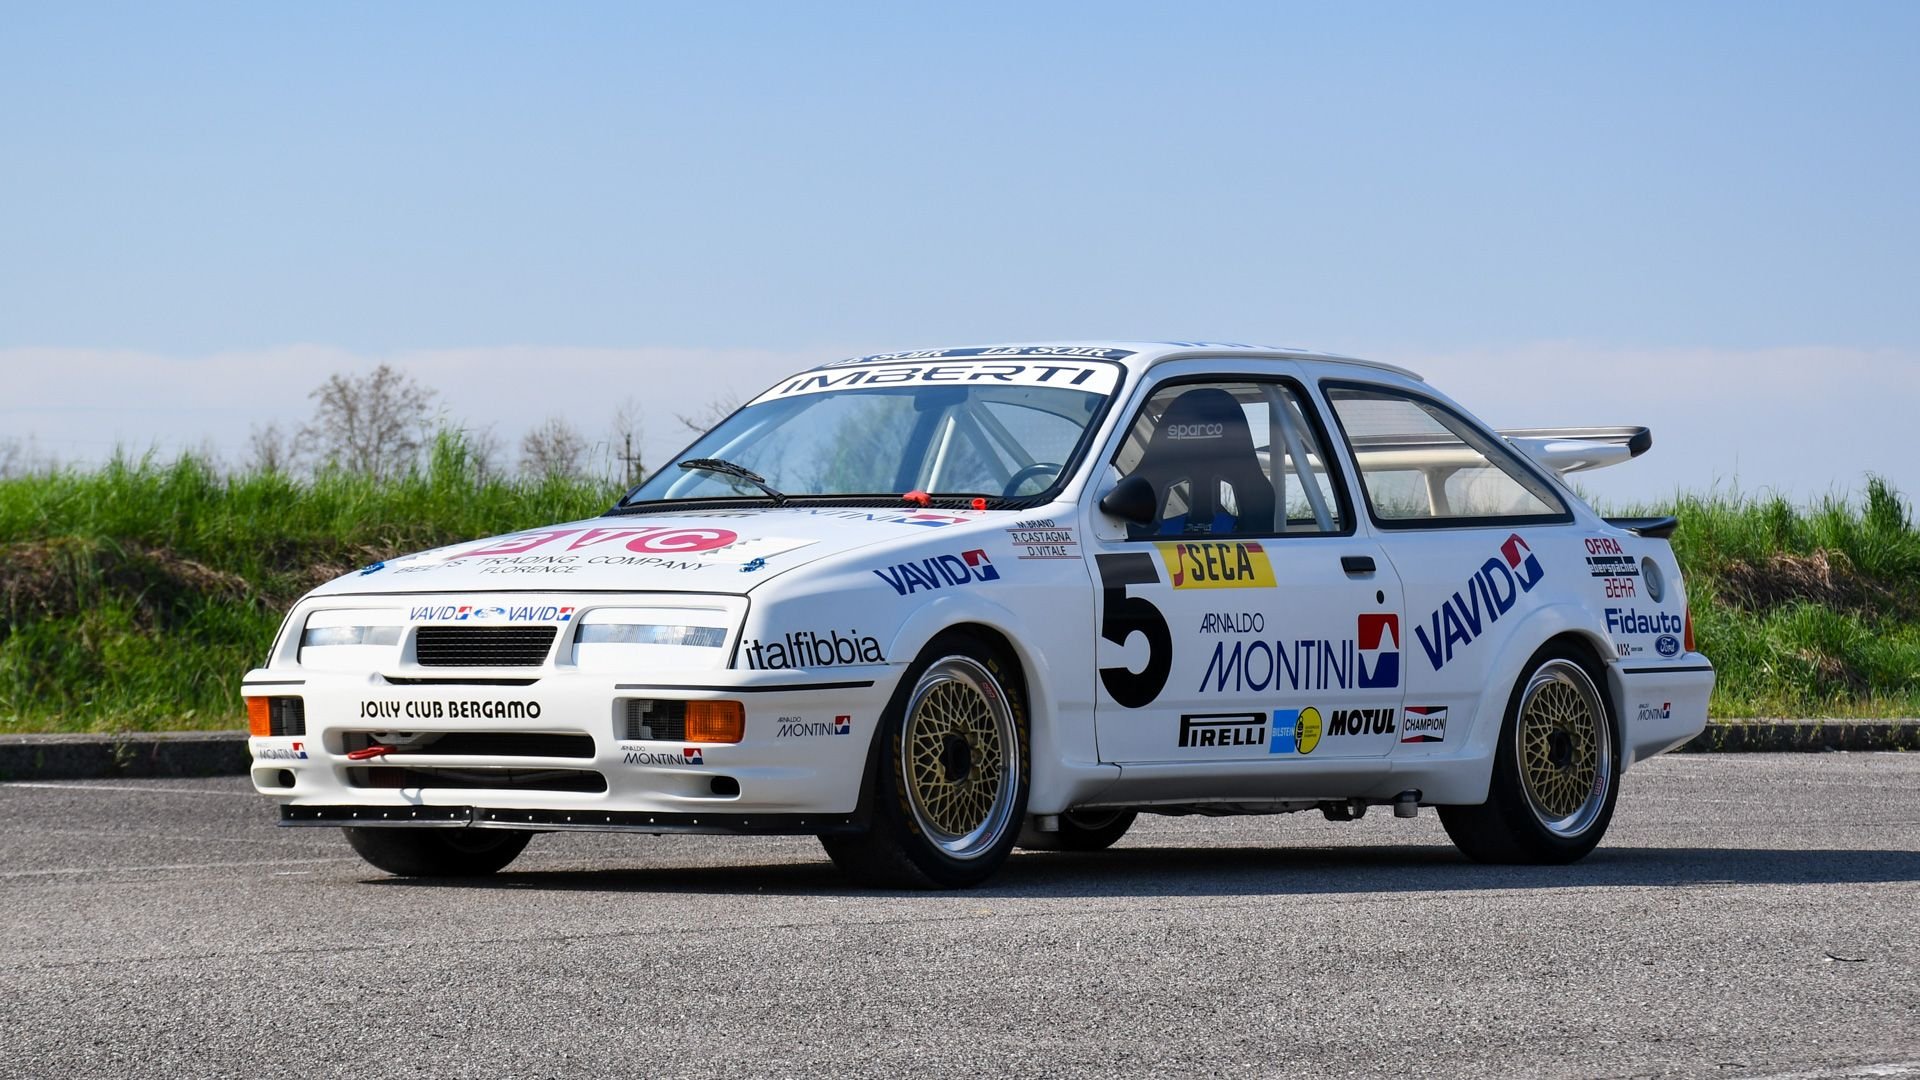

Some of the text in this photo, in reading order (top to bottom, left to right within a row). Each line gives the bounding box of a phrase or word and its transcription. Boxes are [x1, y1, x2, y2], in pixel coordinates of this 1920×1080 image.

[1029, 346, 1113, 357] SOIR
[780, 365, 1097, 394] IMBERTI
[1167, 422, 1223, 439] sparco
[1012, 531, 1072, 543] R.CASTAGNA
[1585, 538, 1623, 555] OFIRA
[1027, 546, 1067, 556] D.VITALE
[476, 555, 580, 566] TRADING
[587, 555, 715, 572] COMPANY
[480, 565, 586, 575] FLORENCE
[1187, 543, 1255, 581] SECA
[873, 556, 971, 596] VAVID
[1604, 578, 1636, 598] BEHR
[409, 606, 456, 621] VAVID
[507, 606, 557, 621] VAVID
[1200, 613, 1265, 633] ARNALDO
[1414, 557, 1516, 671] VAVID
[1604, 608, 1682, 634] Fidauto
[1094, 552, 1173, 709] 5
[743, 629, 884, 670] italfibbia
[1199, 640, 1353, 693] MONTINI
[361, 700, 541, 720] JOLLY CLUB BERGAMO
[776, 723, 834, 738] MONTINI
[1178, 712, 1267, 748] PIRELLI
[1327, 708, 1396, 737] MOTUL
[1404, 717, 1445, 733] CHAMPION
[623, 753, 685, 766] MONTINI
